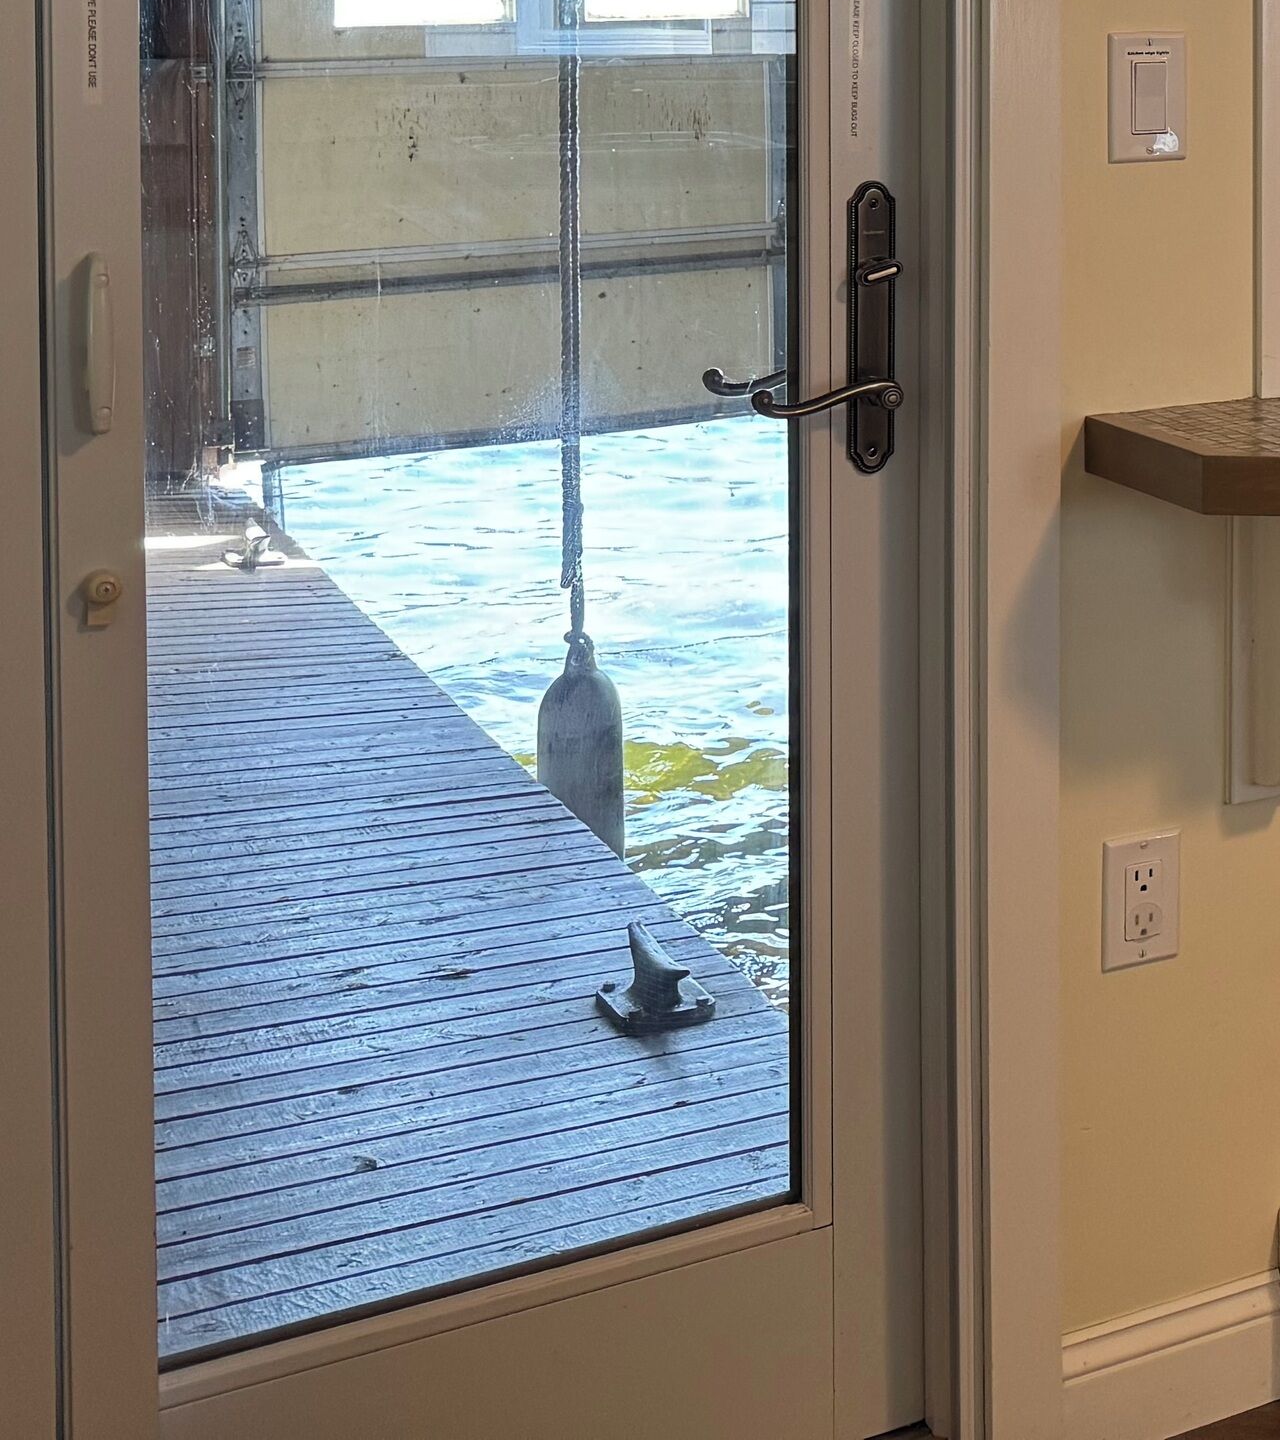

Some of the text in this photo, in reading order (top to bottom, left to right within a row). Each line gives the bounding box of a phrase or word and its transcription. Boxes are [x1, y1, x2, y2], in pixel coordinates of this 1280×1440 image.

[87, 9, 97, 42] PLEASE
[852, 20, 860, 39] KEEP
[88, 43, 97, 69] DON'T
[851, 40, 859, 69] CLOSED
[88, 70, 97, 88] USE
[851, 70, 859, 80] TO
[851, 81, 859, 100] KEEP
[850, 101, 858, 121] BUGS
[850, 122, 858, 137] OUT
